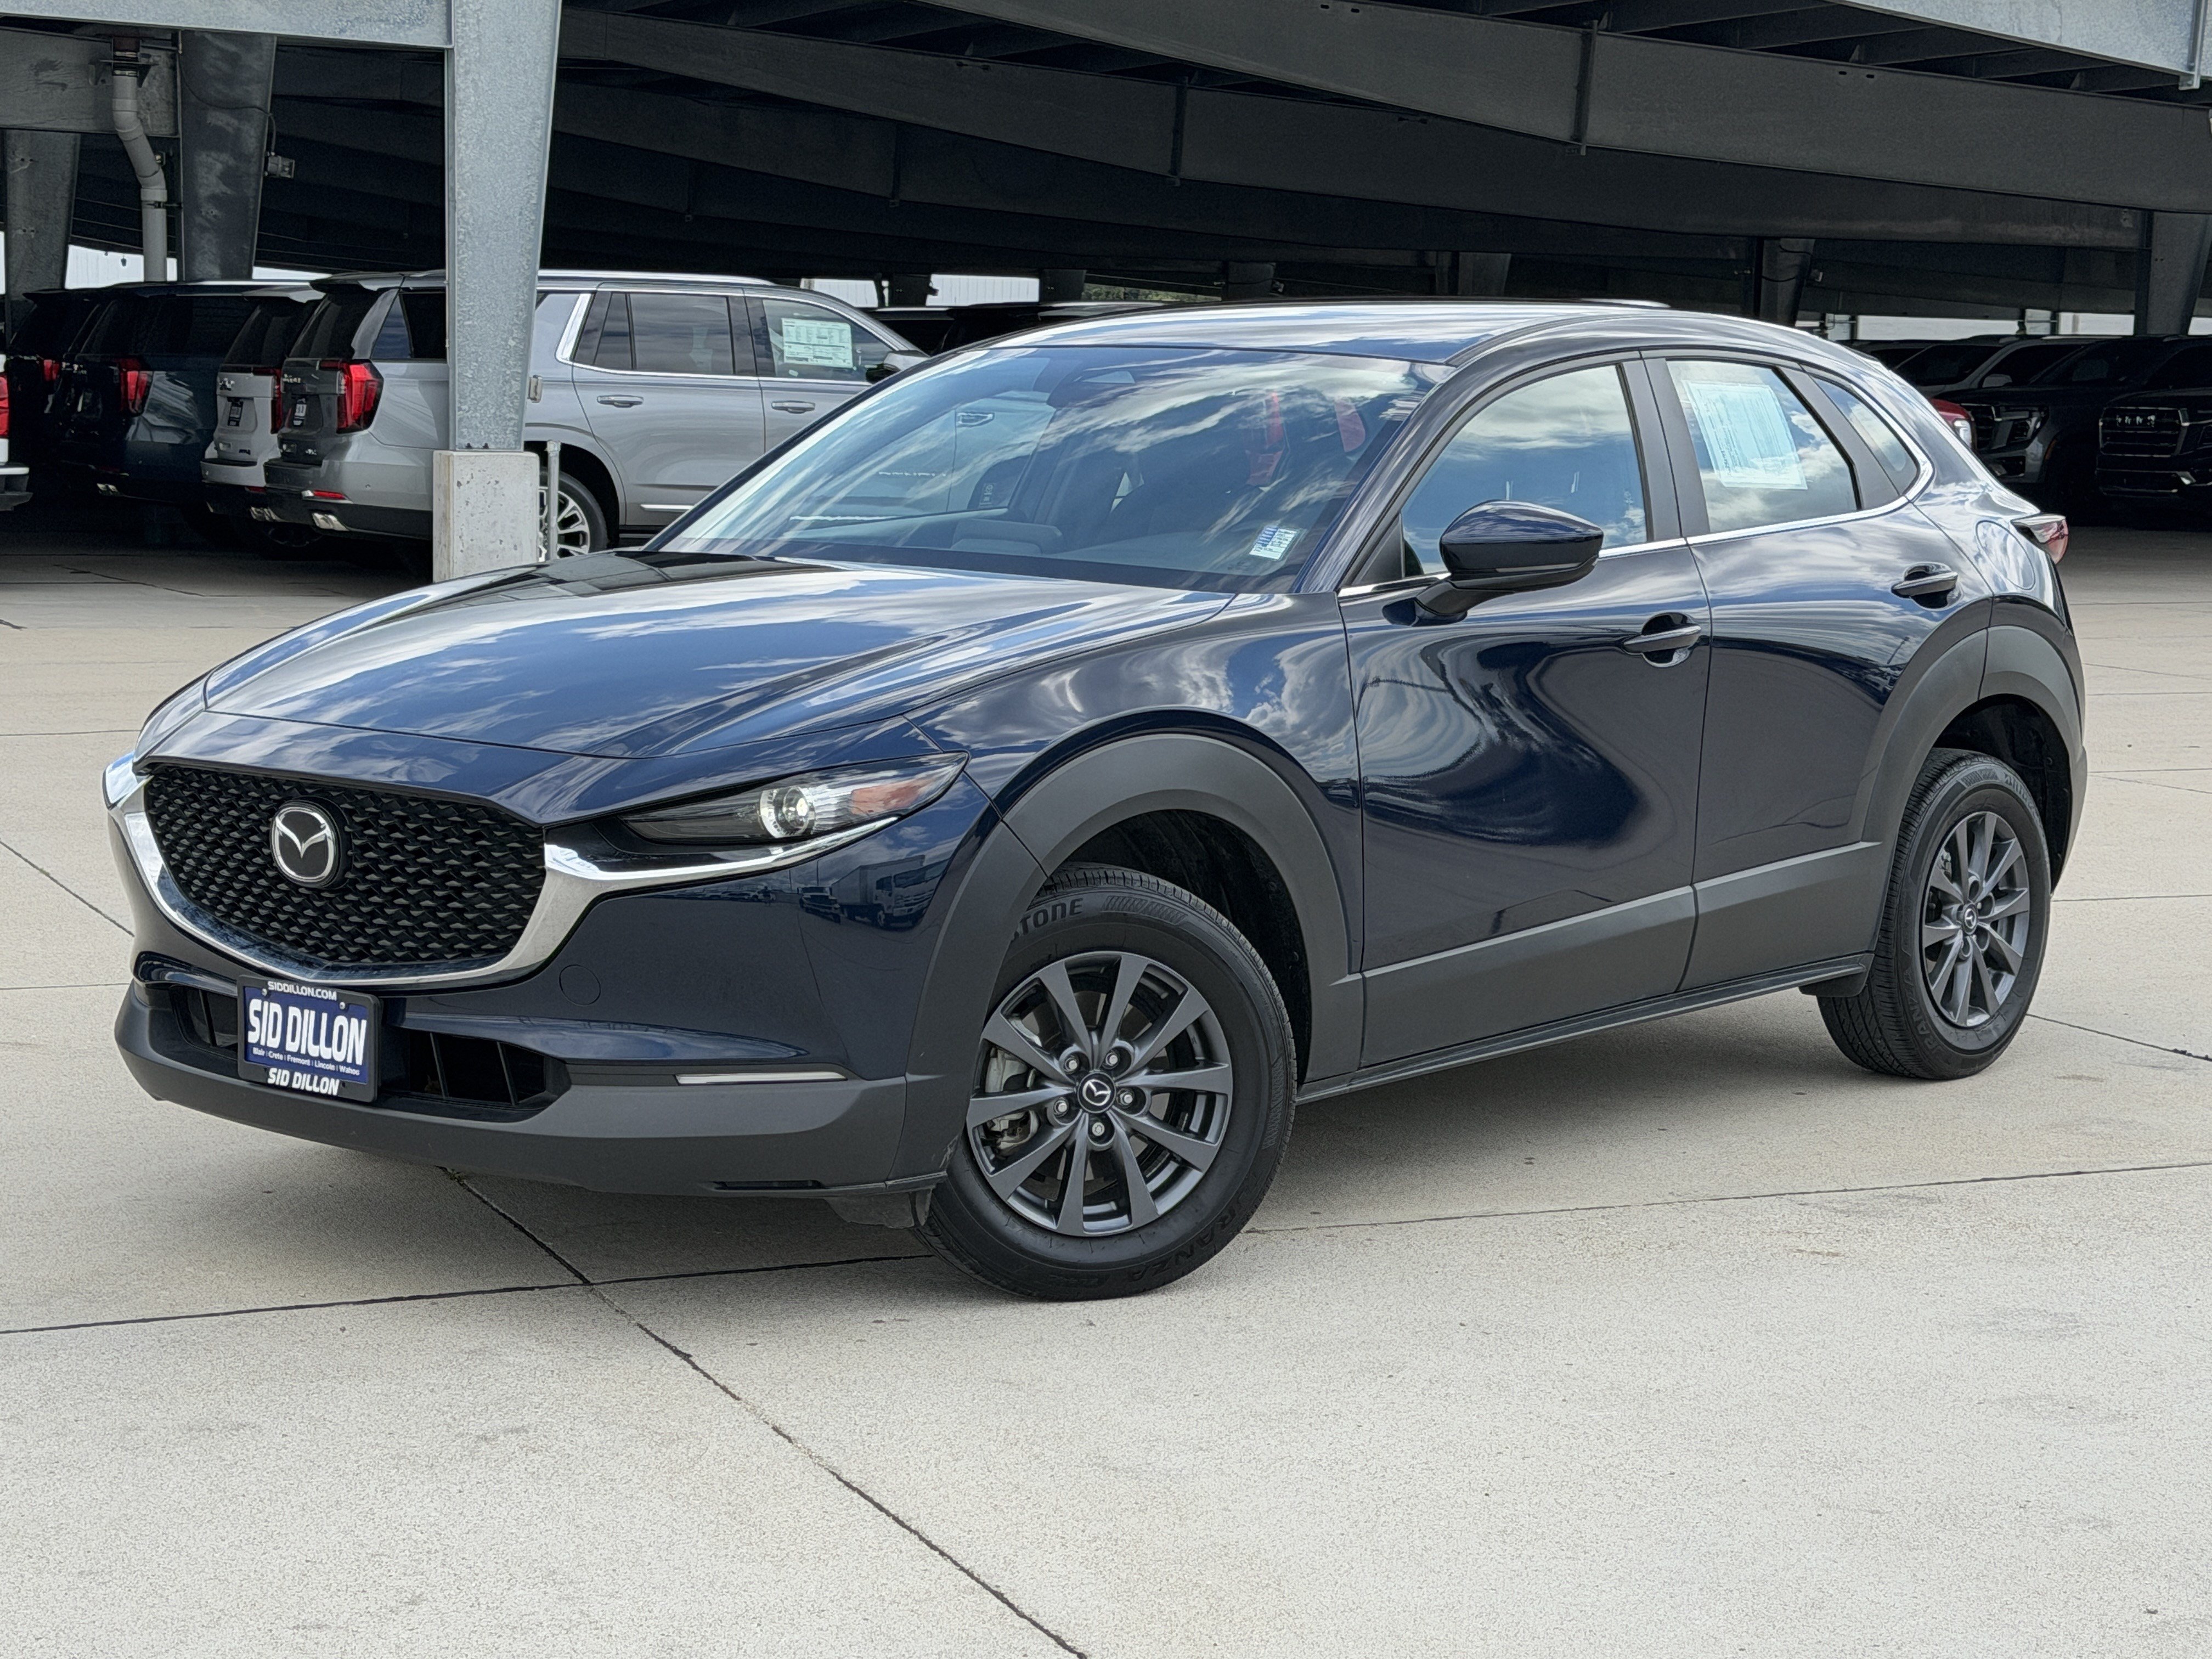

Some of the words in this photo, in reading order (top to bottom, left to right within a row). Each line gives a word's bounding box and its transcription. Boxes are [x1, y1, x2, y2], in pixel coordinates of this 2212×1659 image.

[267, 981, 337, 1001] SIDDILLON.COM
[247, 998, 283, 1048] SID
[285, 1006, 367, 1065] DILLON
[268, 1050, 284, 1060] Crete
[287, 1054, 311, 1066] Fremont
[314, 1059, 335, 1071] Lincoln
[267, 1068, 290, 1087] SID
[291, 1071, 340, 1096] DILLON
